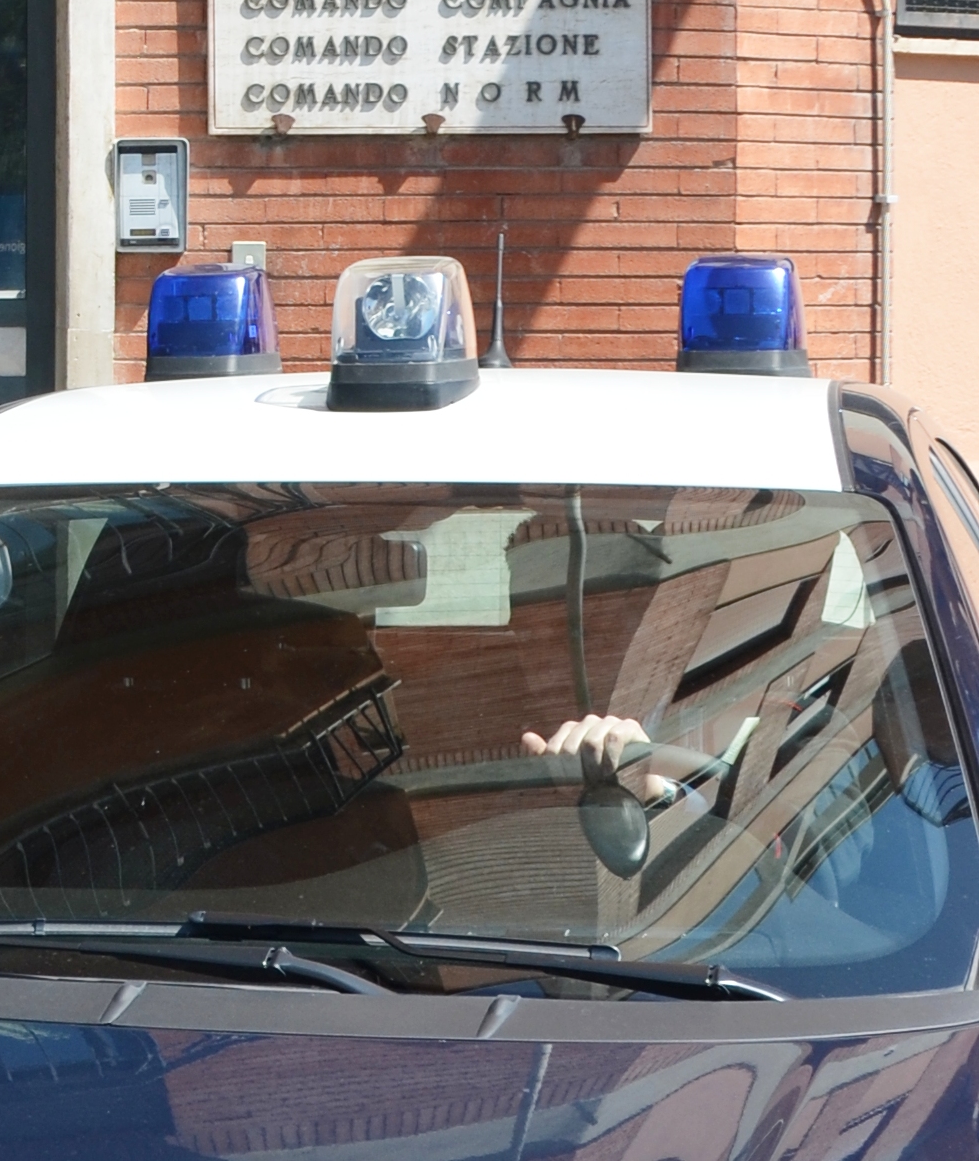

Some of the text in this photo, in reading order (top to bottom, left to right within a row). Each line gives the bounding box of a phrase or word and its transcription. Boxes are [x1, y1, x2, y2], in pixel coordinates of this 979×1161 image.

[244, 34, 601, 58] COMANDO STAZIONE
[244, 83, 408, 105] COMANDO
